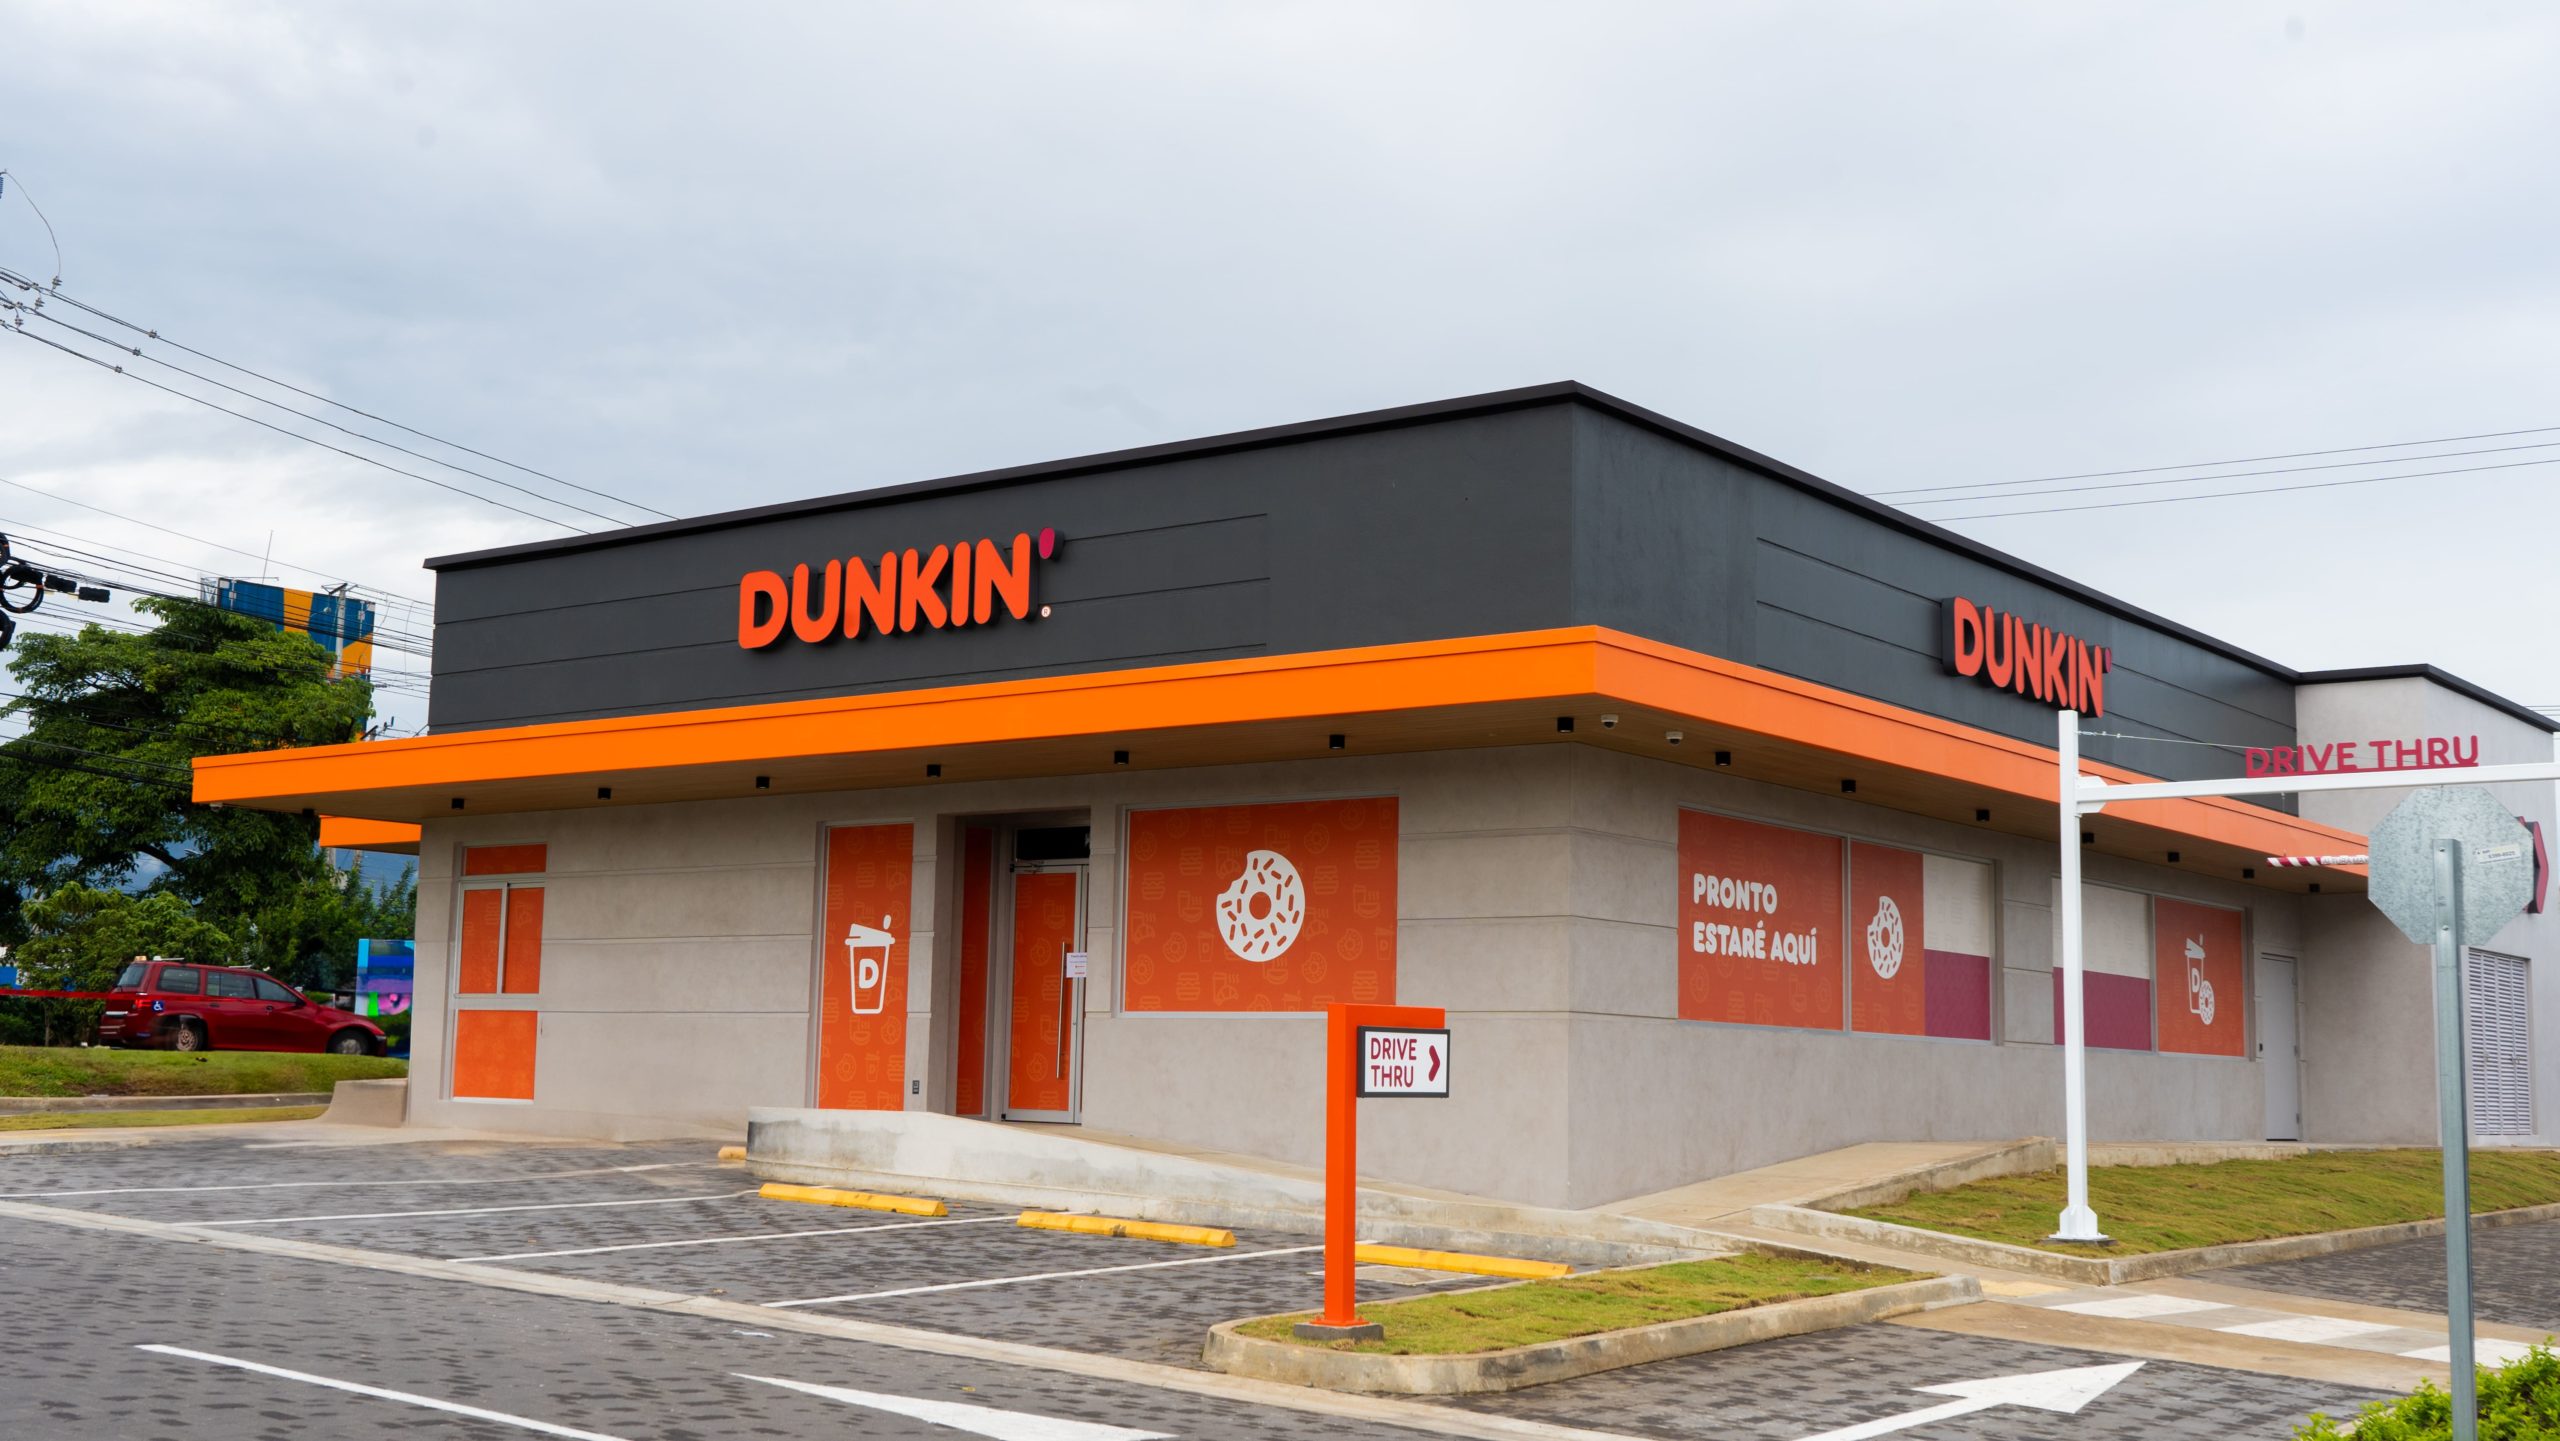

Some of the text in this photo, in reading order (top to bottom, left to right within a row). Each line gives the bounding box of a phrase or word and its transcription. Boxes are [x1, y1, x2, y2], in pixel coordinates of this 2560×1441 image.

[738, 527, 1055, 649] DUNKIN'
[1954, 596, 2112, 718] DUNKIN'
[2246, 735, 2479, 778] DRIVE THRU
[1693, 873, 1778, 914] PRONTO
[1693, 920, 1817, 965] ESTARÉ AQUÍ
[859, 958, 879, 989] D
[1371, 1037, 1417, 1060] DRIVE
[1371, 1065, 1414, 1088] THRU
